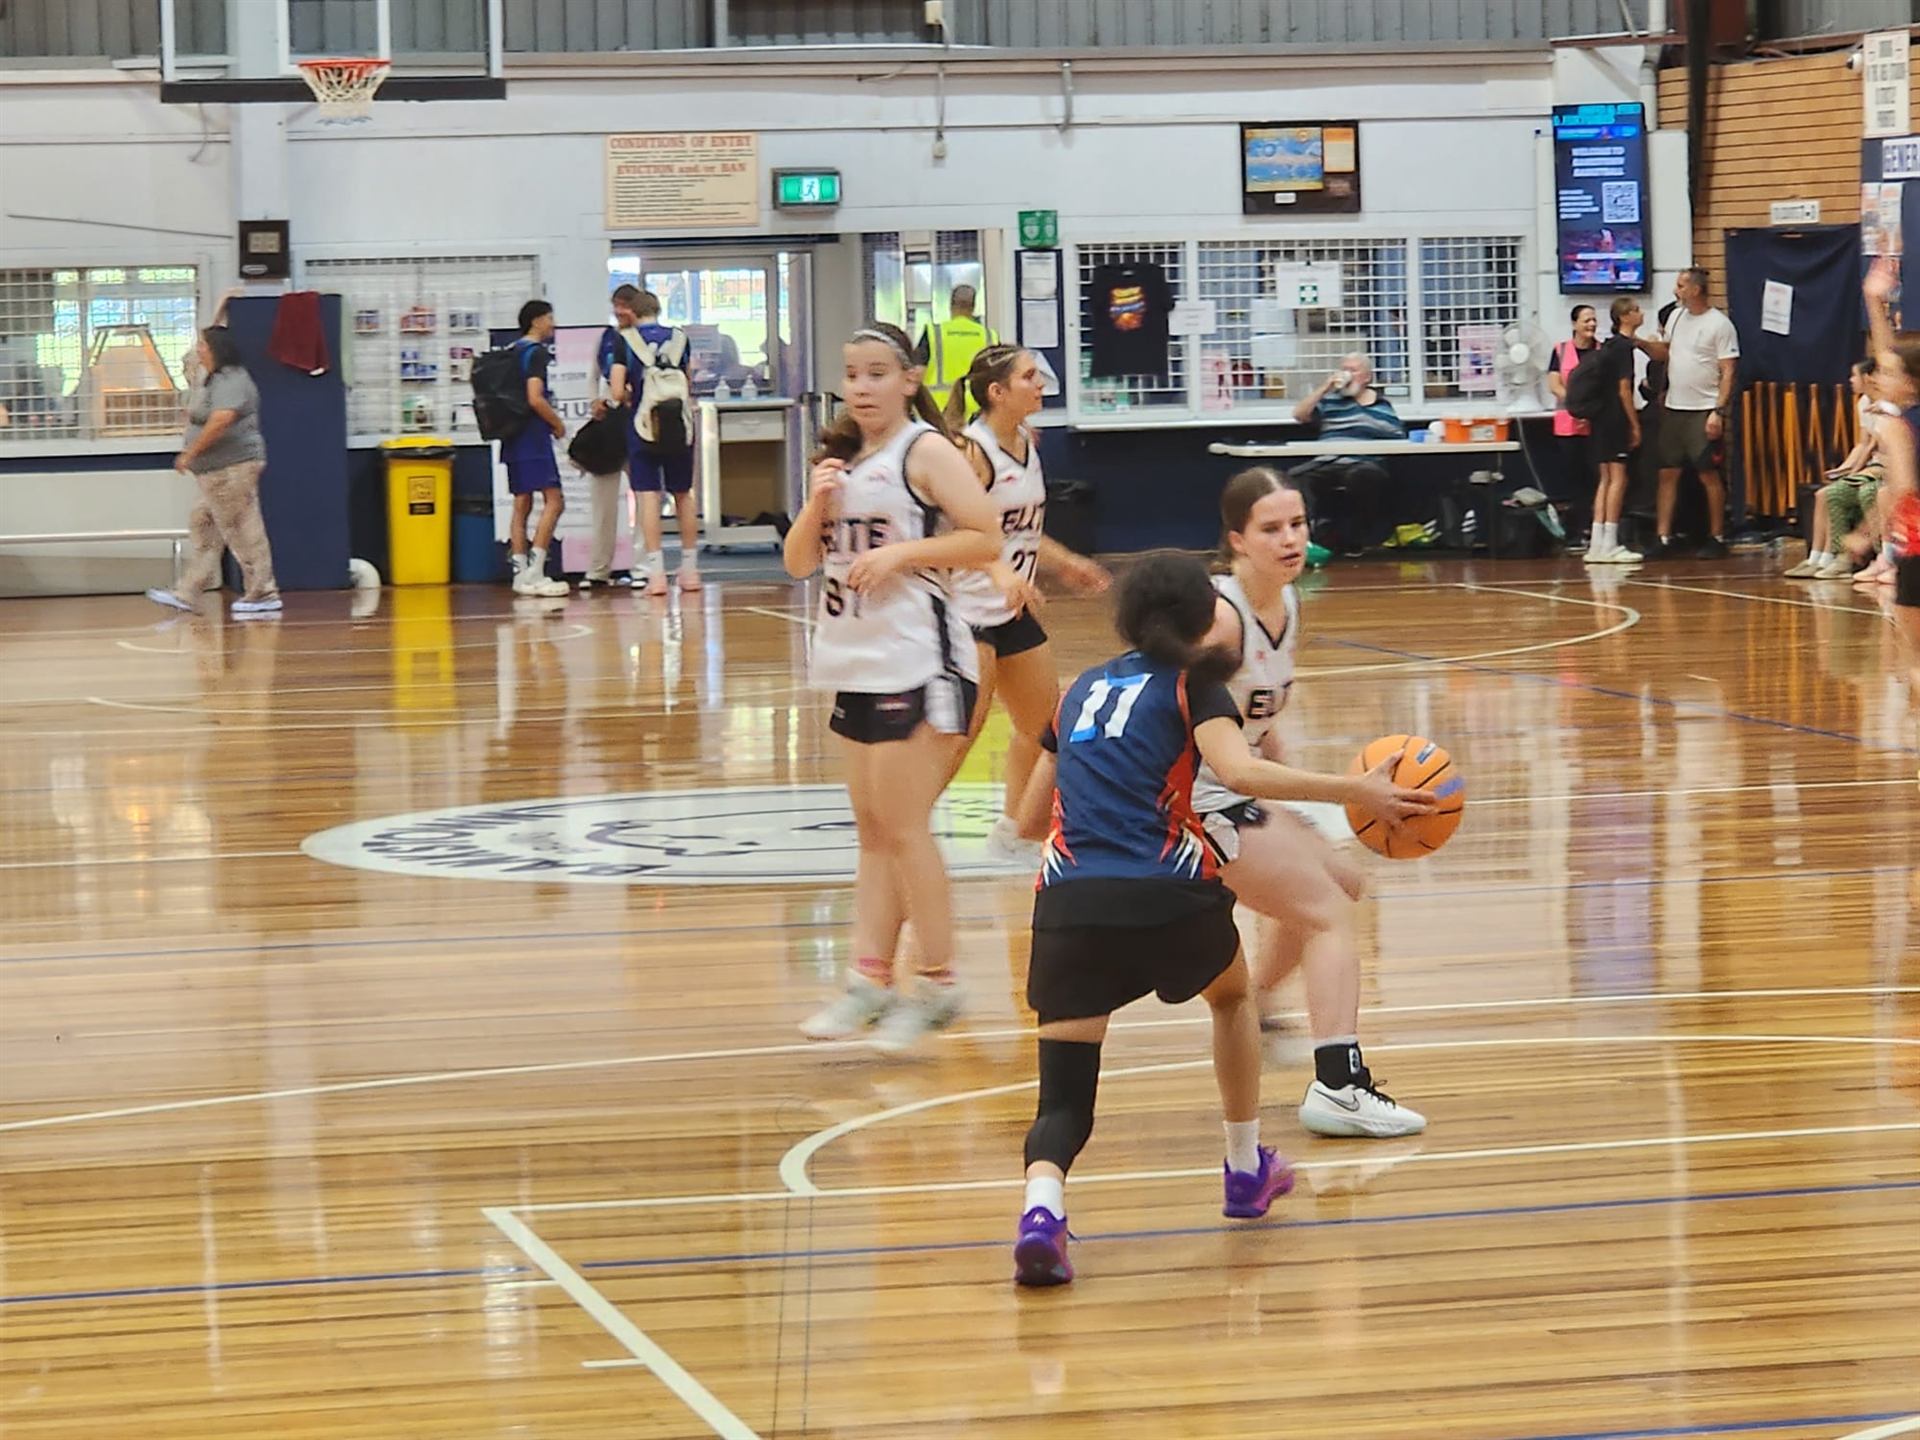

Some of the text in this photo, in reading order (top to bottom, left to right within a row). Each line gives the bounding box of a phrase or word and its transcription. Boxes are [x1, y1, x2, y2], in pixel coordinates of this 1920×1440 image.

[610, 135, 751, 149] CONDITIONS OF ENTRY
[616, 164, 674, 174] EVICTION
[1012, 549, 1037, 582] 27
